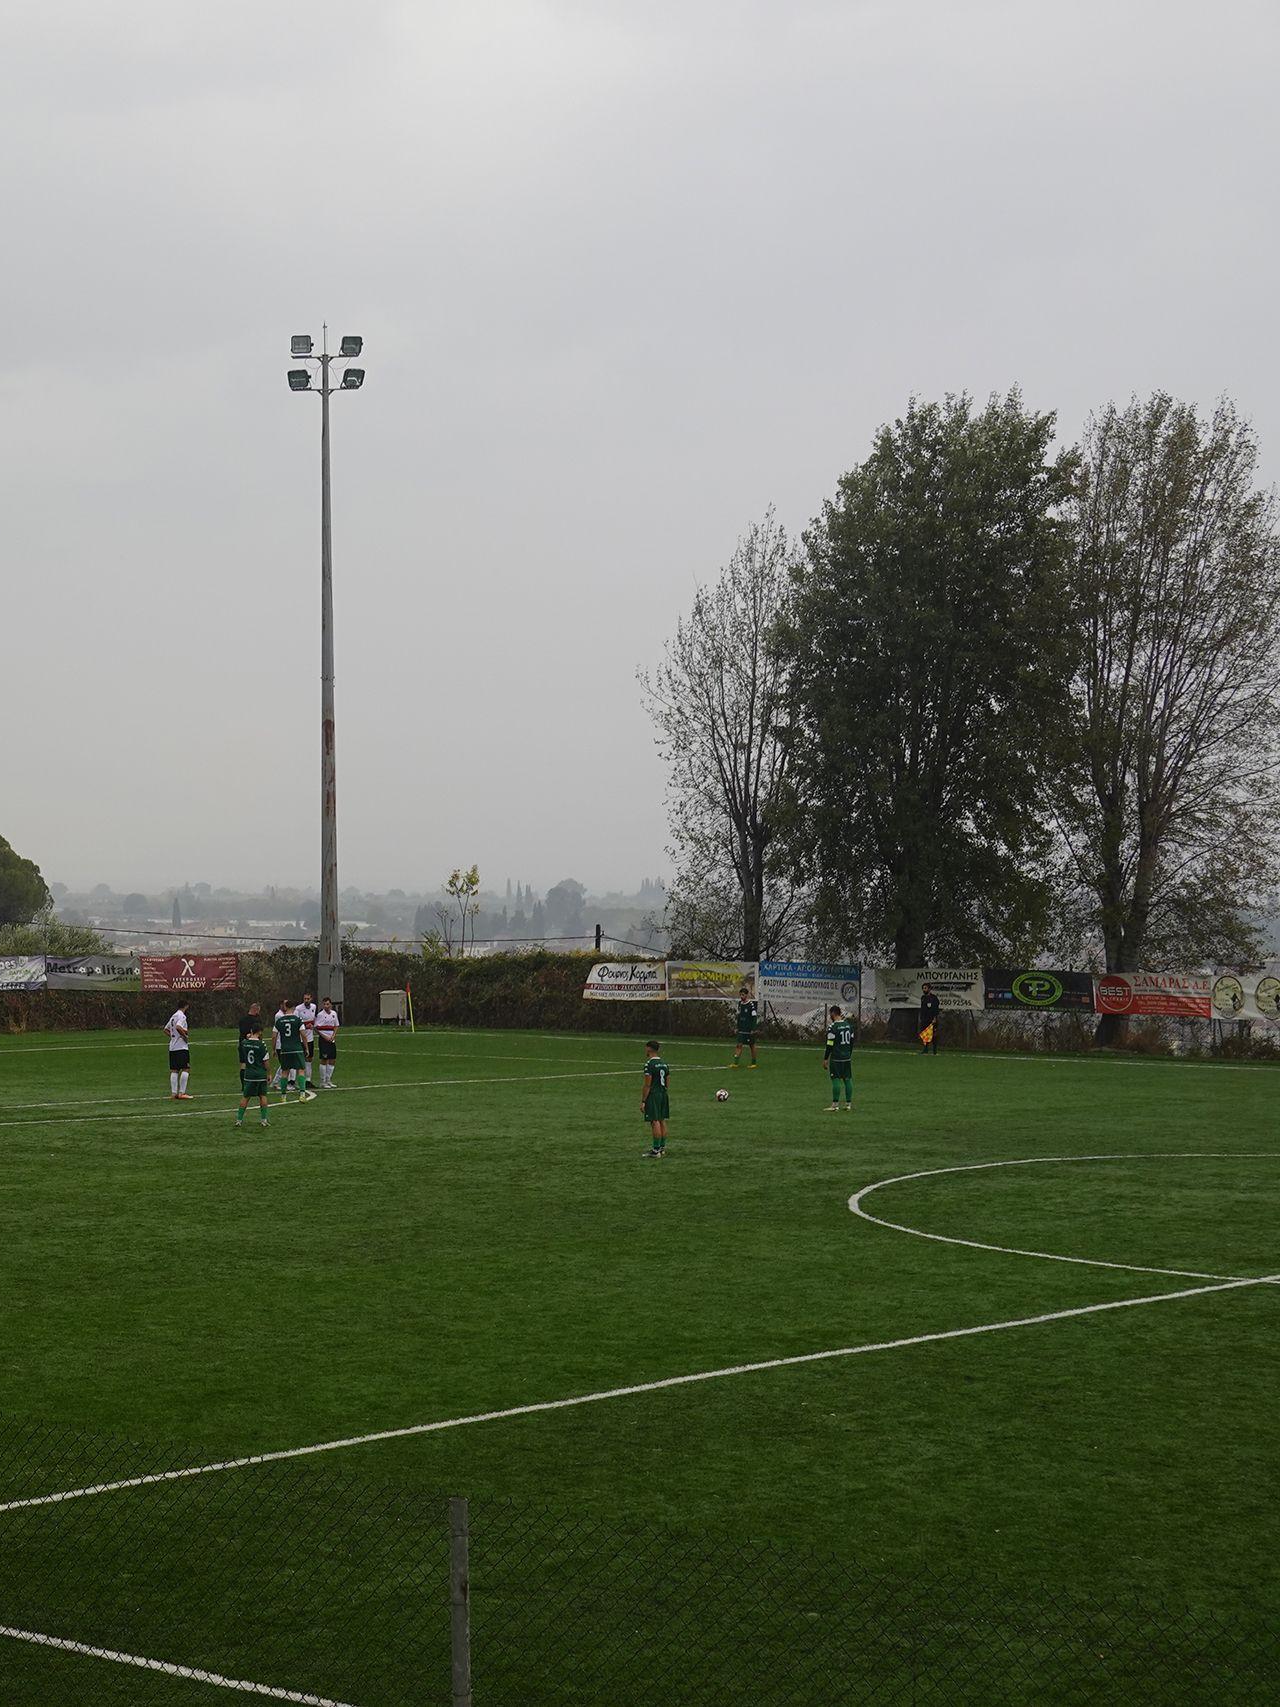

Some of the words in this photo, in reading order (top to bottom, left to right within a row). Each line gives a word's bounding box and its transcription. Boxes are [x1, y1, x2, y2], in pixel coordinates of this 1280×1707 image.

[916, 972, 978, 980] ΜΠΟΥΡΓΑΝΗΣ
[1132, 976, 1189, 988] ΣΑΜΑΡΑΣ
[792, 980, 830, 988] ΠΑΠΑΔΟΠΟΥΛΟΣ
[1100, 986, 1130, 996] BEST
[285, 1022, 292, 1036] 3
[840, 1030, 851, 1044] 10
[247, 1050, 255, 1064] 6
[660, 1069, 665, 1086] 8
